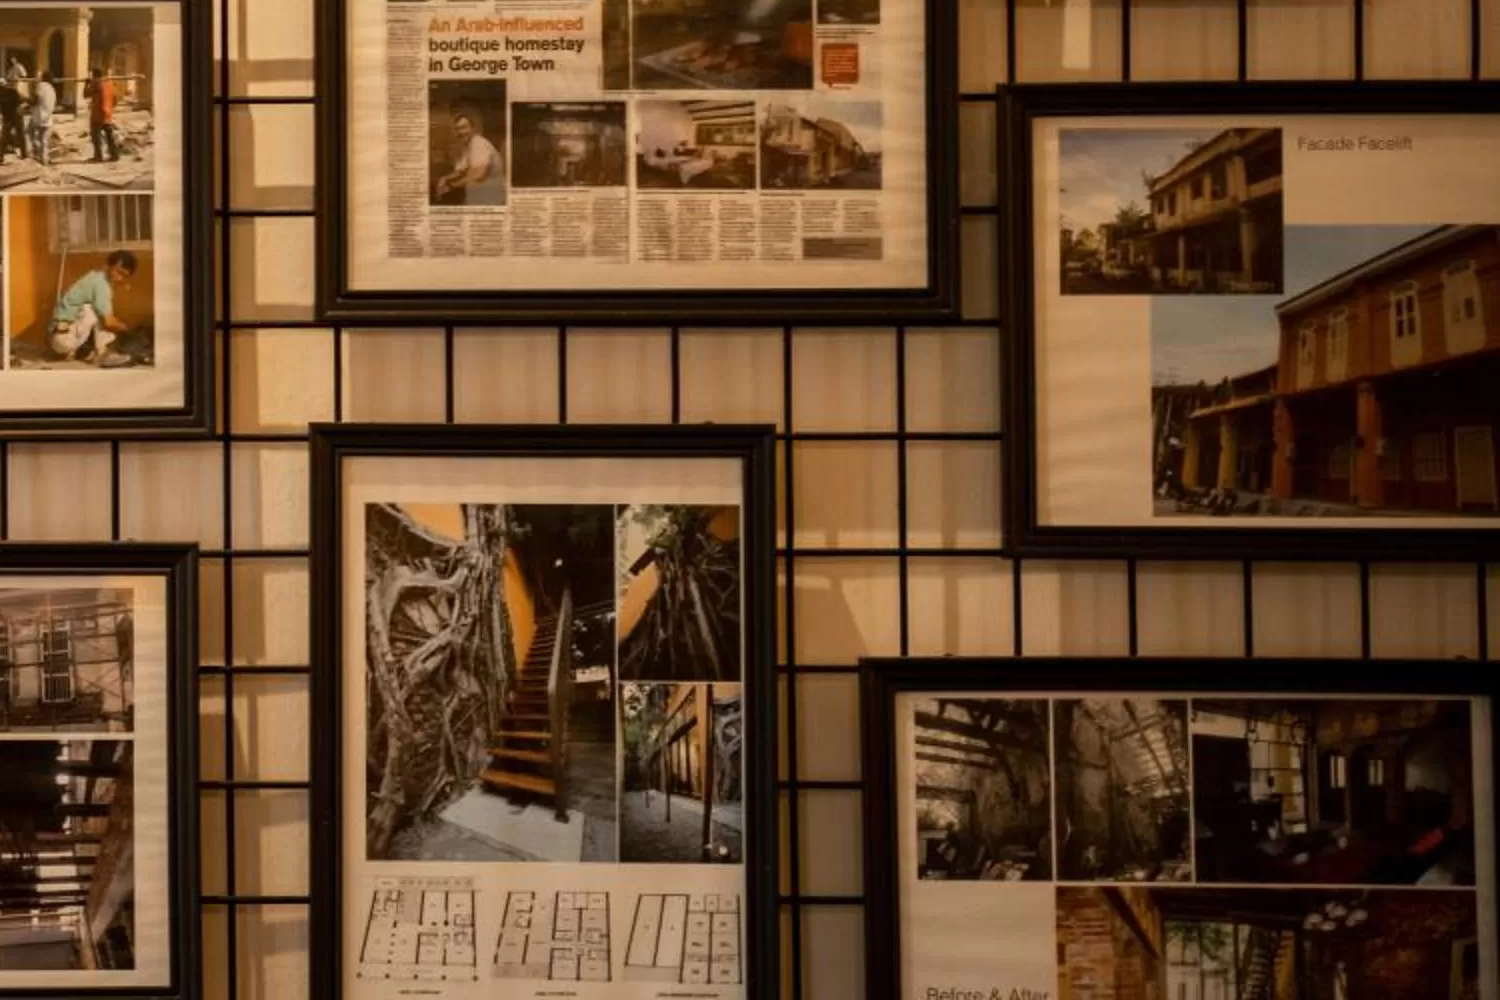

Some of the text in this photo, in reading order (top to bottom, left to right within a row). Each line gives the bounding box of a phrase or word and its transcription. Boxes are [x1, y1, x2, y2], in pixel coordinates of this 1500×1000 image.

[428, 17, 584, 32] An Arab-influenced
[428, 36, 585, 53] boutique homestay
[428, 56, 555, 74] in George Town
[1297, 136, 1412, 151] Facade Facelift
[926, 987, 983, 1000] Before
[1010, 987, 1049, 1000] After
